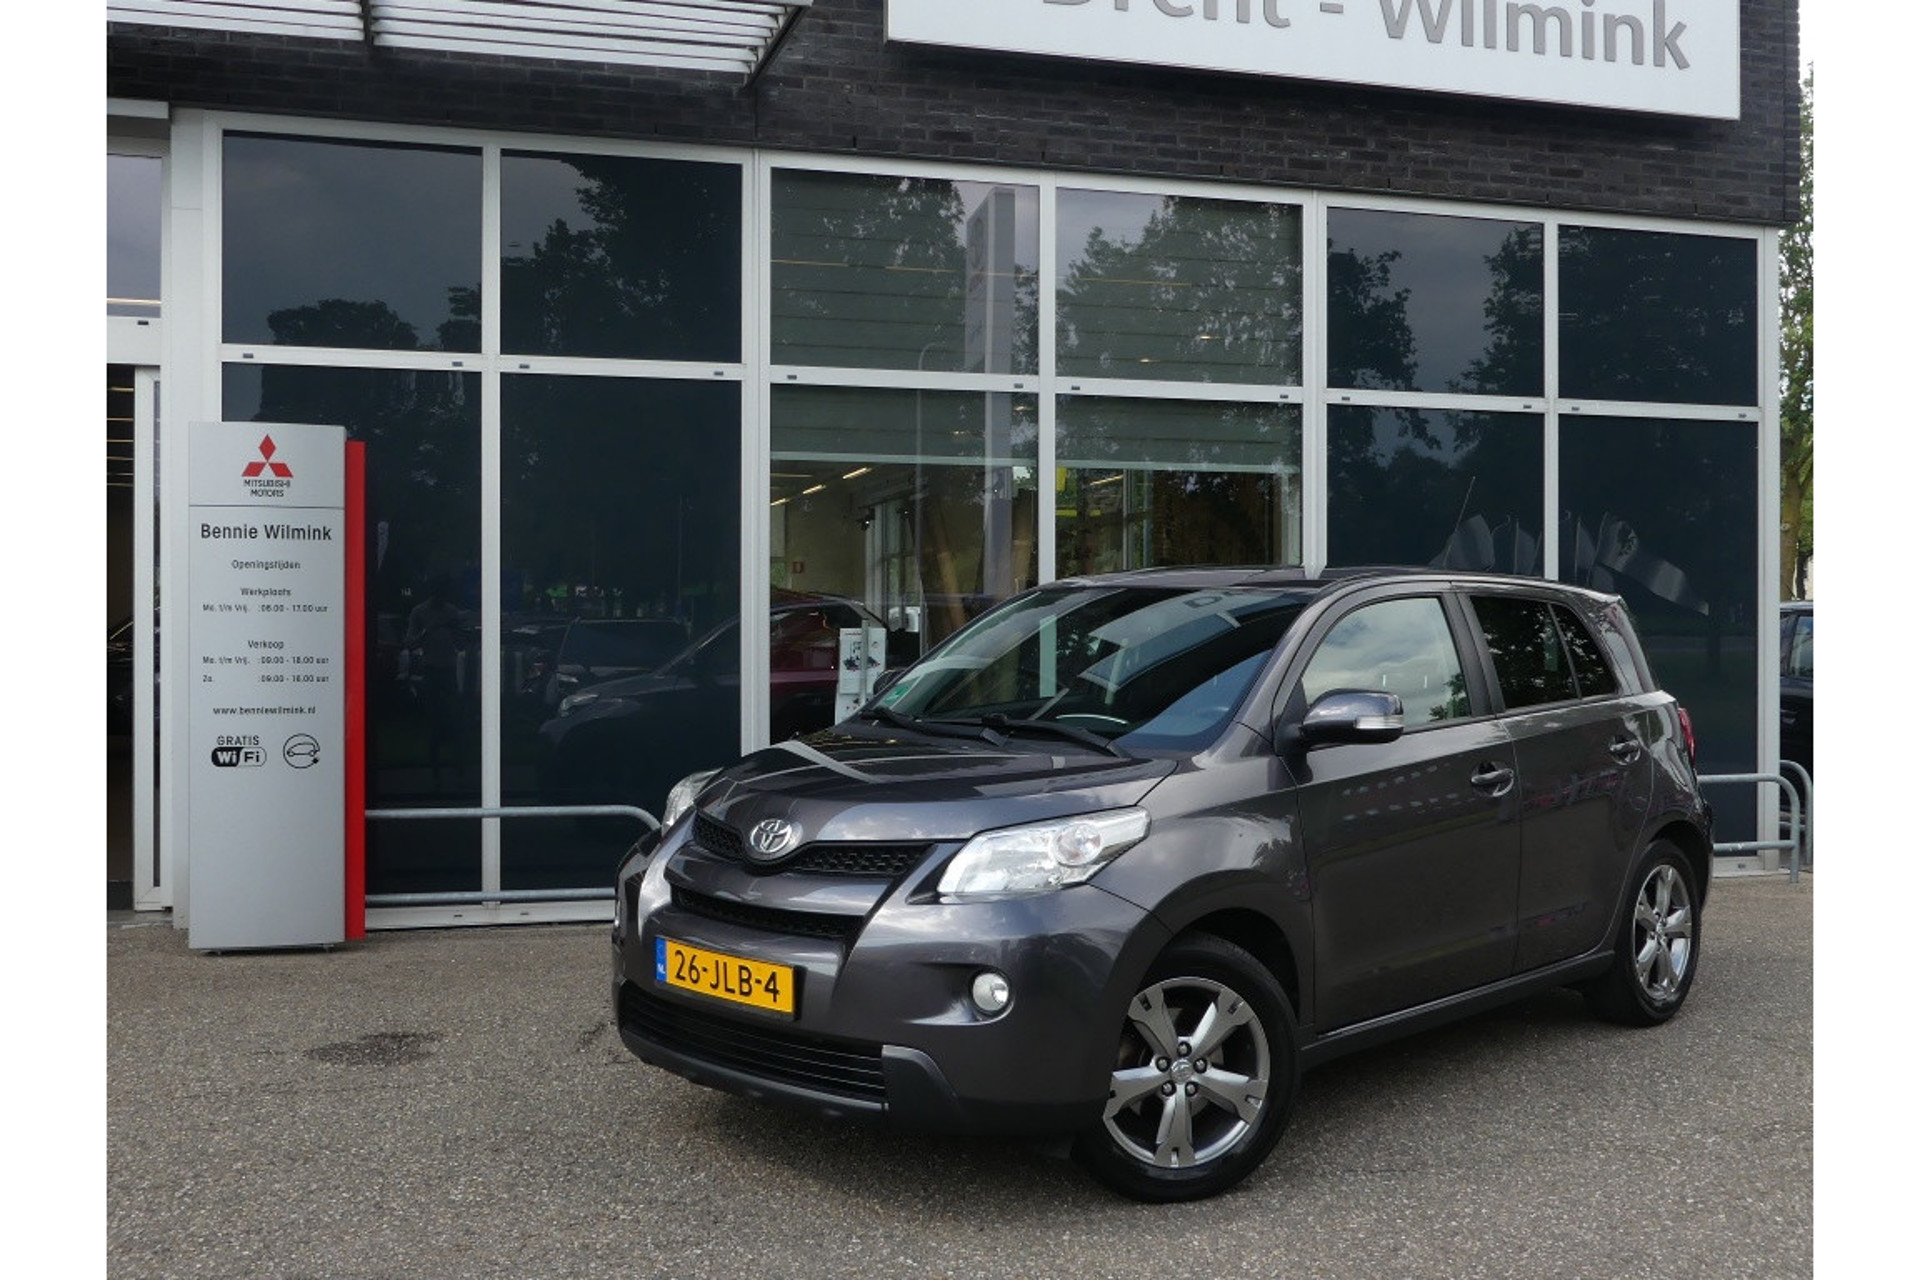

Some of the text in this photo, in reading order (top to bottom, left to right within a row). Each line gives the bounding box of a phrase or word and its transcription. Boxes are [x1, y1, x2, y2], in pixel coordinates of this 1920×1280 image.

[243, 479, 291, 488] MITSUBISHI
[250, 489, 284, 498] MOTORS
[201, 523, 332, 541] Bennie Wilmink
[231, 559, 301, 571] Openingstijden
[240, 588, 292, 598] Werkplaats
[315, 605, 328, 613] uur
[247, 640, 285, 650] Verkoop
[212, 706, 316, 715] www.benniewilmink.nl
[216, 735, 260, 746] GRATIS
[674, 949, 780, 1003] 26-JLB-4
